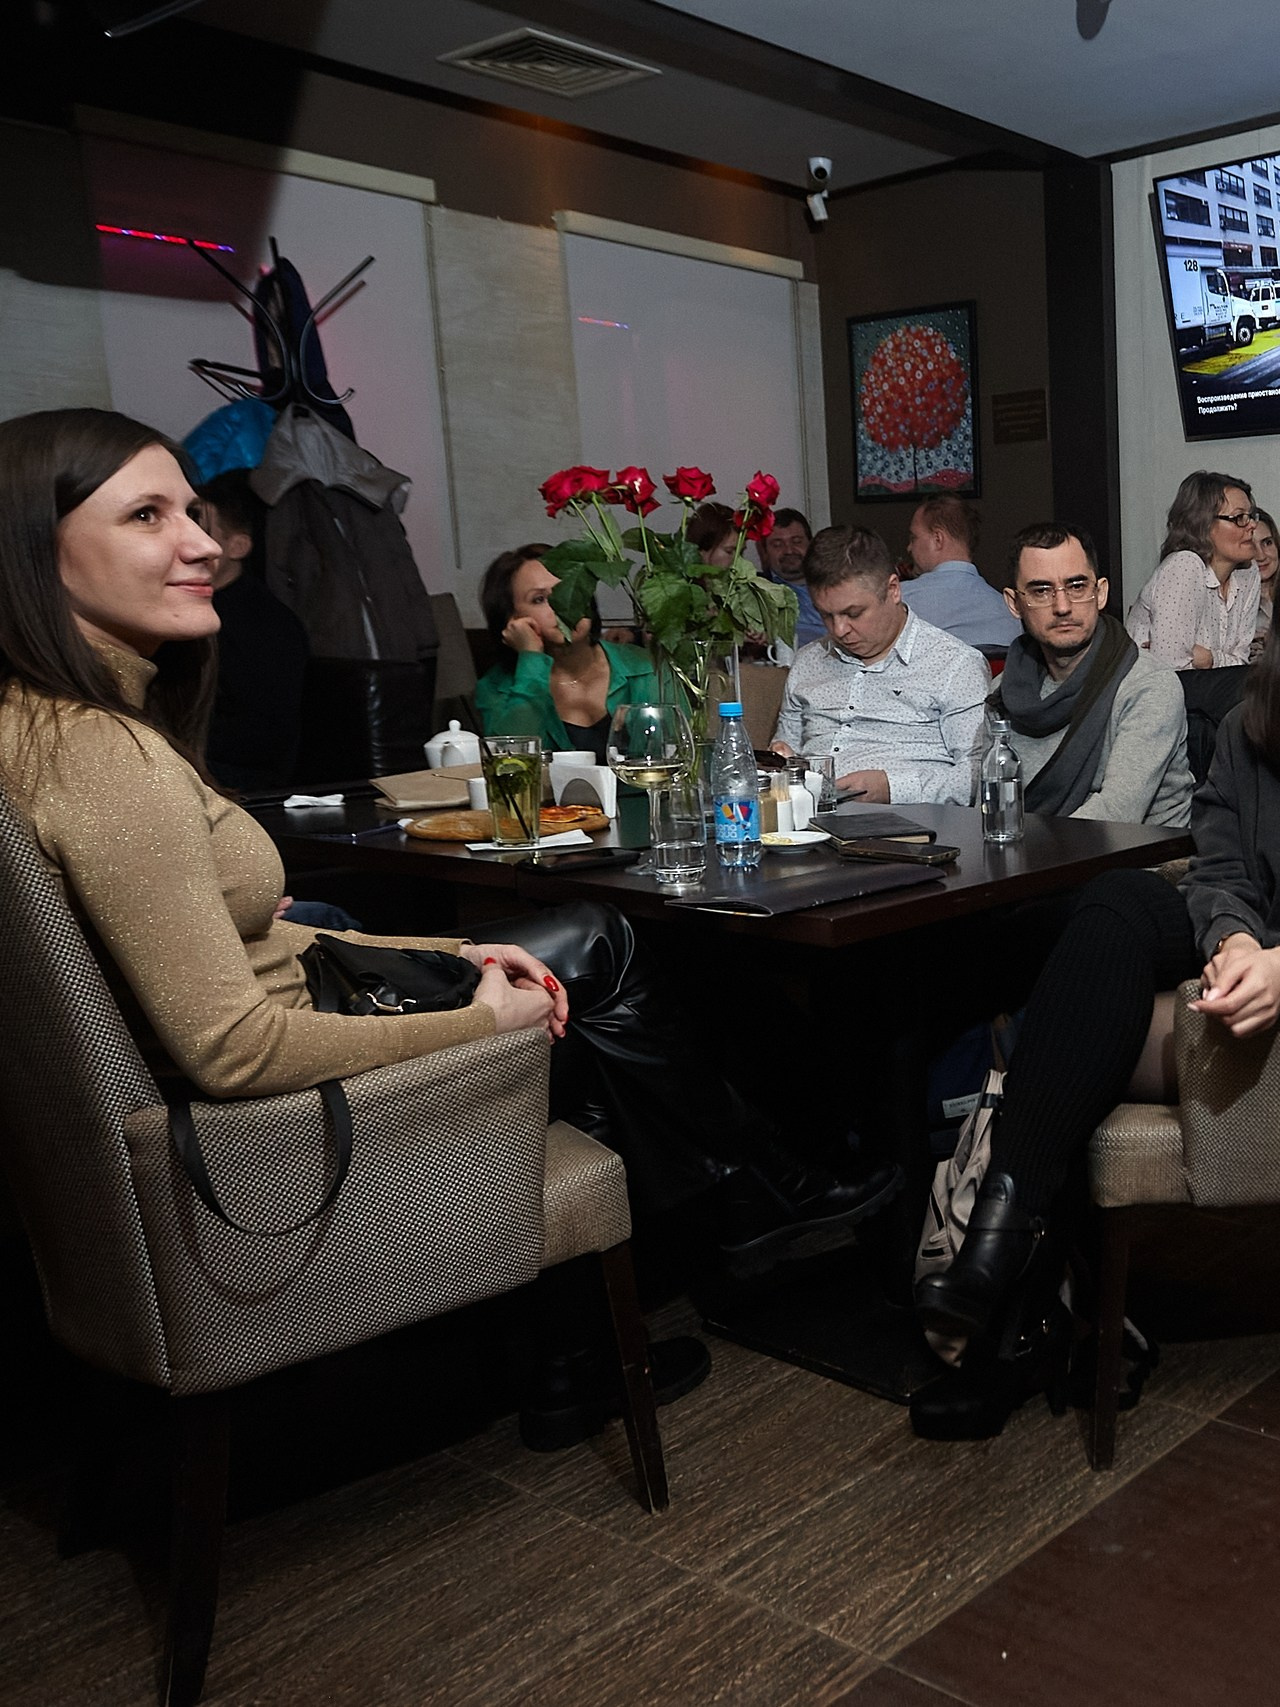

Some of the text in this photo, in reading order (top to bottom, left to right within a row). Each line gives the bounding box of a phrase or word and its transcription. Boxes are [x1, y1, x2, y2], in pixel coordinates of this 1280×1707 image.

[1184, 259, 1198, 272] 128
[1196, 392, 1247, 404] Воспроизведение
[1198, 403, 1238, 415] Продолжить?
